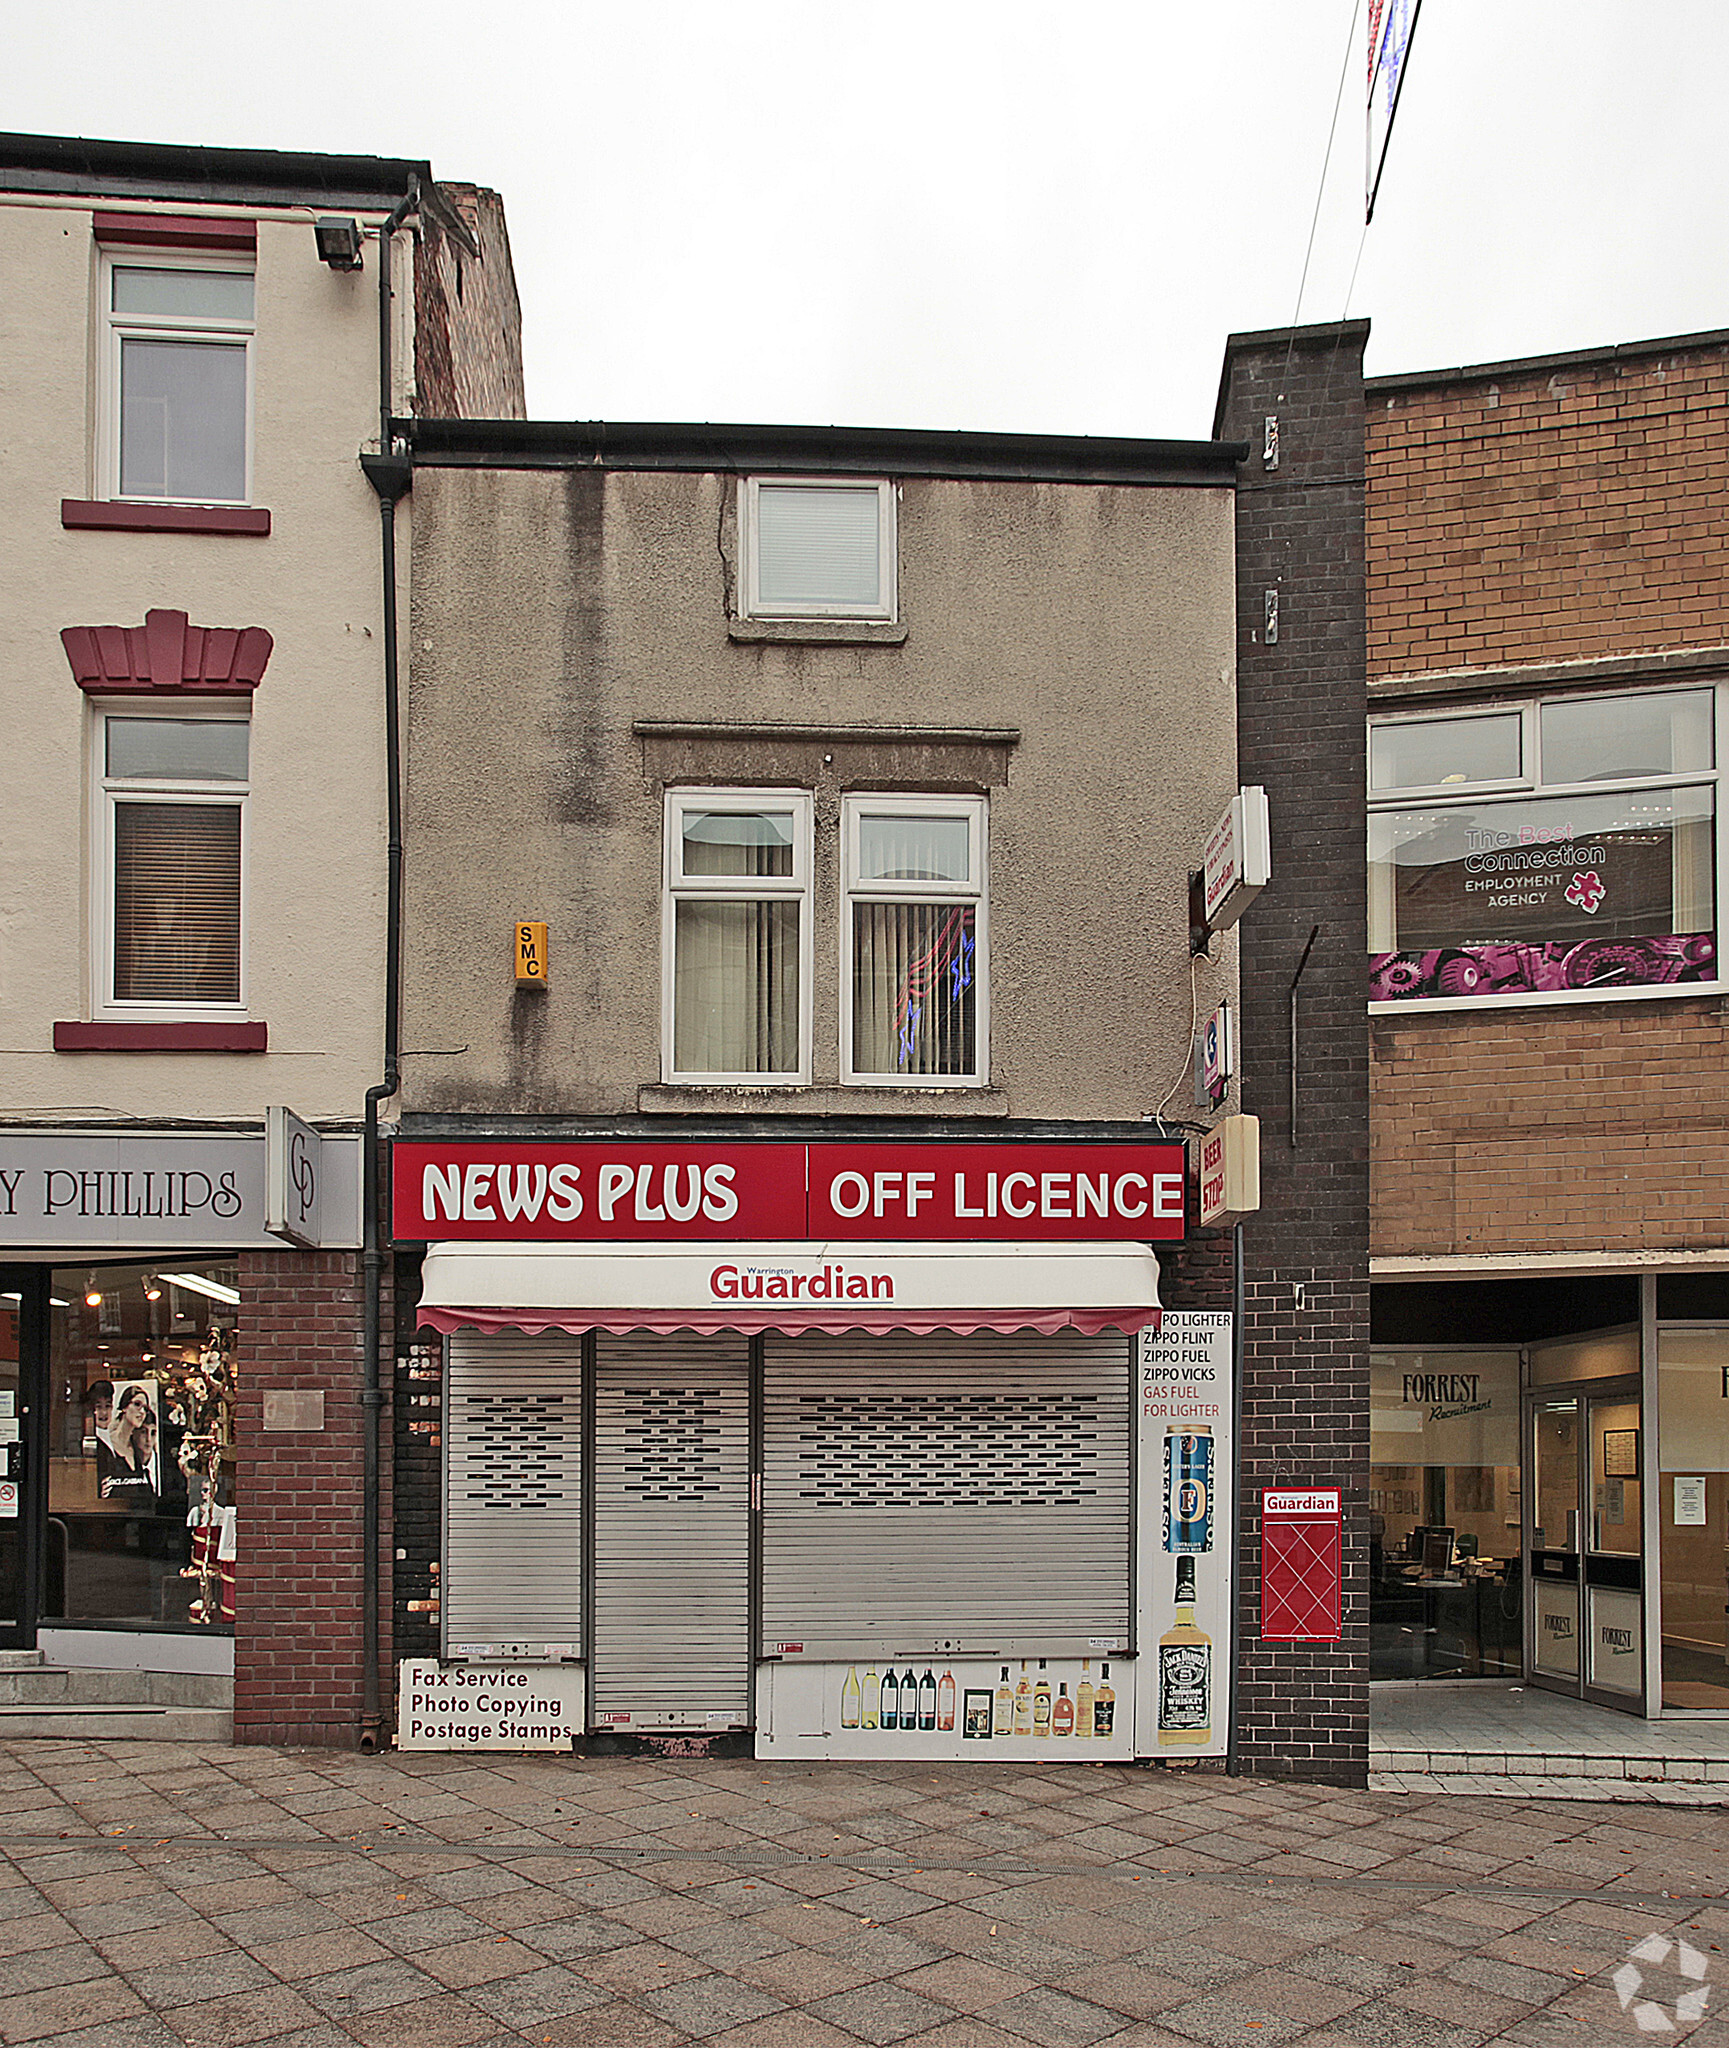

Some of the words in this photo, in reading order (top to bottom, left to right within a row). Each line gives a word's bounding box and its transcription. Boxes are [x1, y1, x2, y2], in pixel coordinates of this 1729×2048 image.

[1465, 830, 1511, 849] The
[1518, 822, 1574, 844] Best
[1465, 845, 1606, 873] Connection
[1207, 860, 1234, 906] Guardian
[1465, 874, 1562, 892] EMPLOYMENT
[1488, 892, 1548, 907] AGENCY
[1204, 1136, 1222, 1171] BEER
[0, 1170, 25, 1215] Y
[43, 1170, 242, 1218] PHILLIPS
[422, 1163, 583, 1222] NEWS
[599, 1163, 739, 1222] PLUS
[829, 1171, 935, 1219] OFF
[954, 1171, 1183, 1219] LICENCE
[1203, 1172, 1224, 1213] STOP
[710, 1264, 894, 1299] Guardian
[747, 1267, 794, 1276] Warrington
[1182, 1313, 1231, 1327] LIGHTER
[1143, 1331, 1179, 1345] ZIPPO
[1182, 1331, 1215, 1345] FLINT
[1143, 1349, 1179, 1363] ZIPPO
[1182, 1349, 1211, 1363] FUEL
[1143, 1367, 1179, 1381] ZIPPO
[1182, 1367, 1216, 1381] VICKS
[1143, 1385, 1168, 1399] GAS
[1171, 1385, 1200, 1399] FUEL
[1402, 1374, 1480, 1402] FORREST
[1144, 1403, 1168, 1417] FOR
[1170, 1403, 1220, 1417] LIGHTER
[1428, 1399, 1492, 1422] Recruitment
[1267, 1495, 1335, 1510] Guardian
[1544, 1614, 1571, 1633] FORREST
[1601, 1626, 1632, 1647] FORREST
[1165, 1653, 1182, 1668] JACK
[412, 1668, 449, 1687] Fax
[455, 1667, 528, 1687] Service
[411, 1694, 469, 1713] Photo
[476, 1694, 562, 1717] Copying
[1167, 1697, 1204, 1706] WHISKEY
[411, 1719, 492, 1743] Postage
[498, 1720, 572, 1742] Stamps
